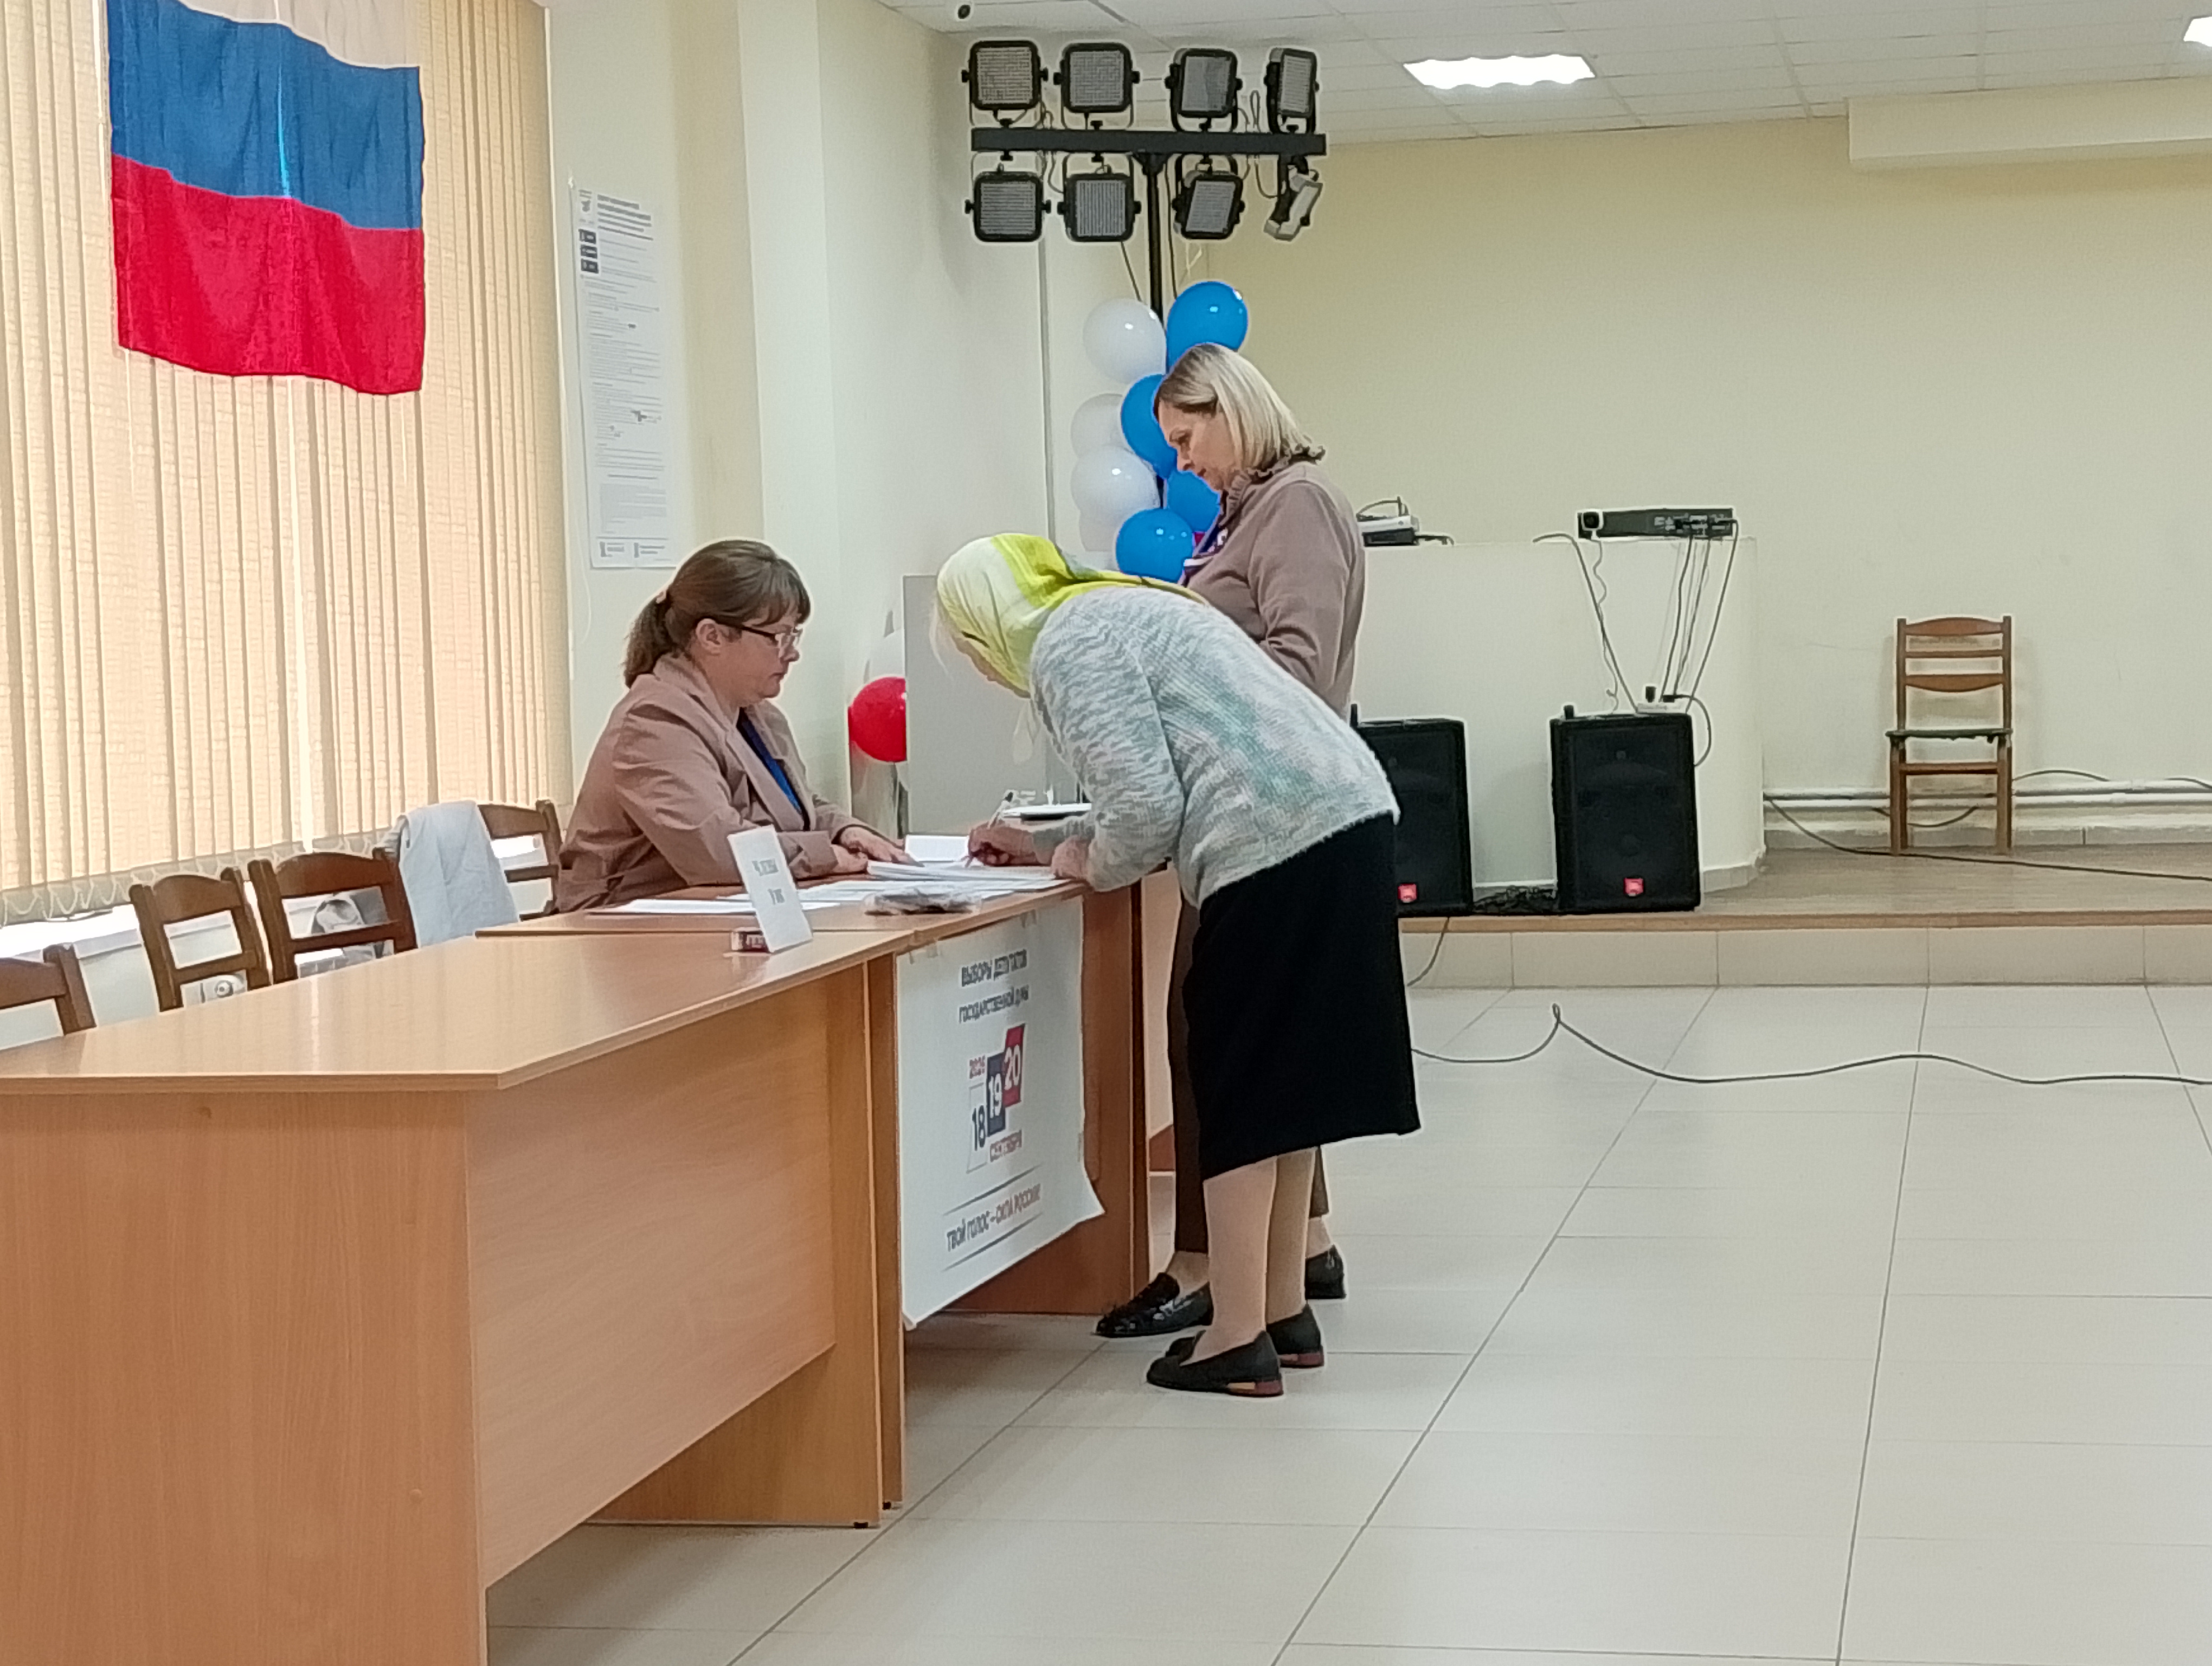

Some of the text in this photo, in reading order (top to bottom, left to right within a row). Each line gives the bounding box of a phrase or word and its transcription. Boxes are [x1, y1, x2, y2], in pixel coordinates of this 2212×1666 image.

[972, 1044, 1021, 1151] 18 19 20
